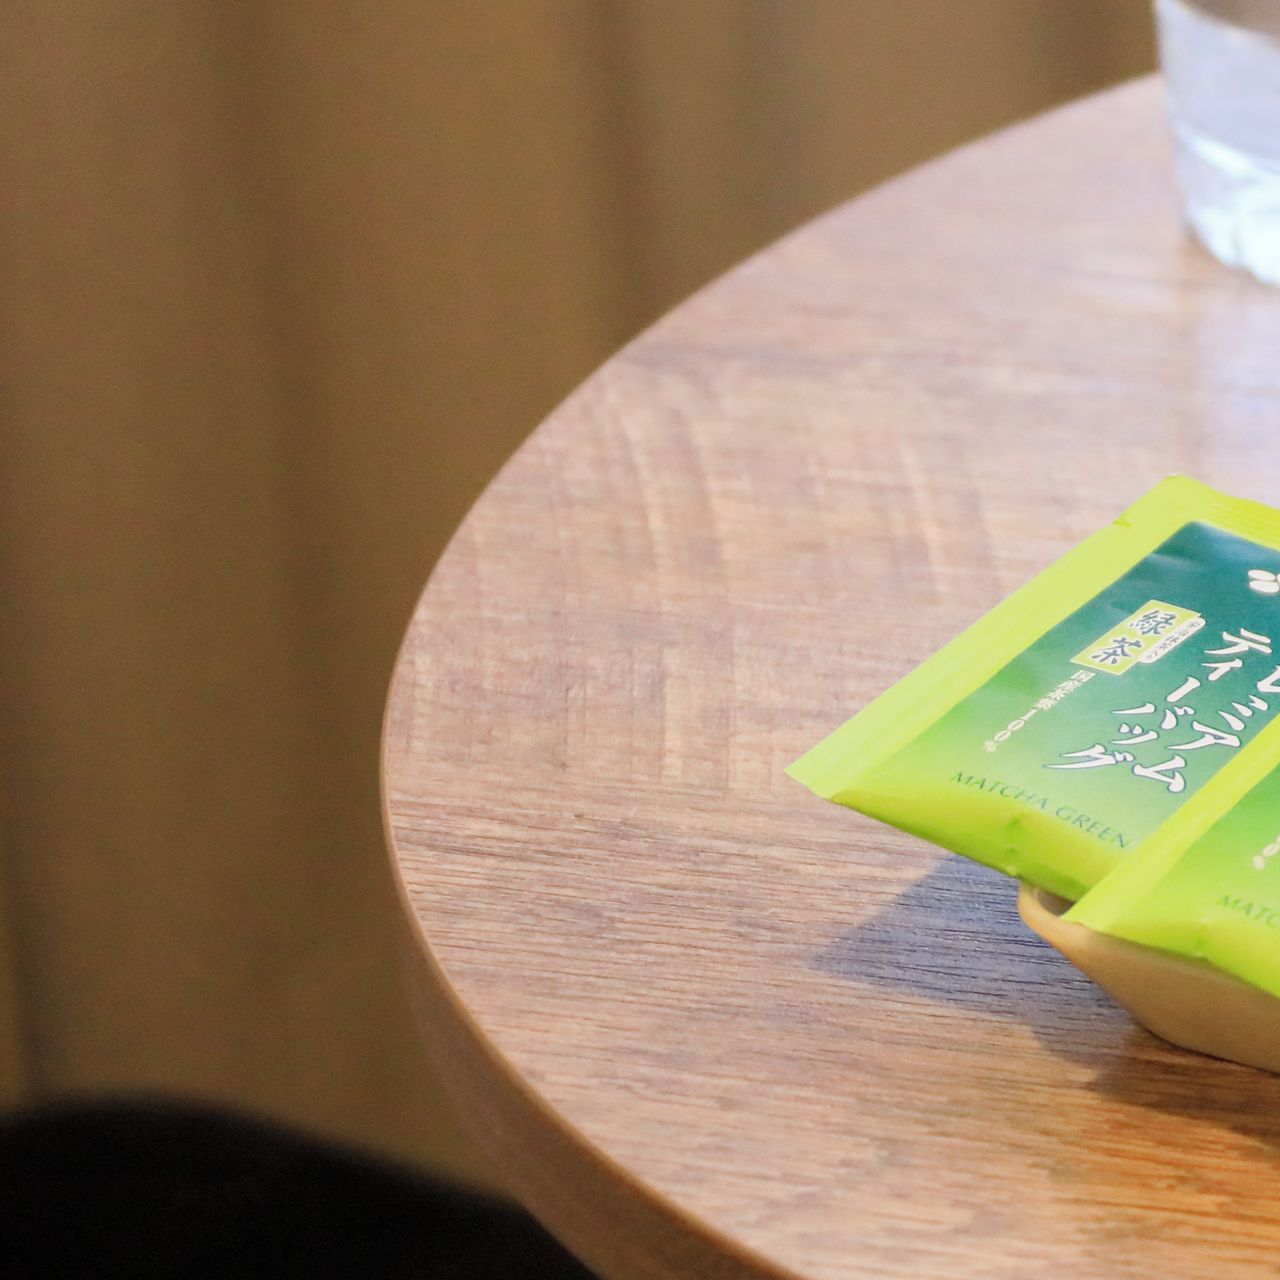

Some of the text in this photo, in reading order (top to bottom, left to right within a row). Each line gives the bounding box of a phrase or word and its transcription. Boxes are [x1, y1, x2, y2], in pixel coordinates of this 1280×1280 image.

[1091, 609, 1177, 665] 緑茶
[1044, 627, 1273, 769] ティーバッグ
[950, 771, 1134, 850] MATCHA GREEN
